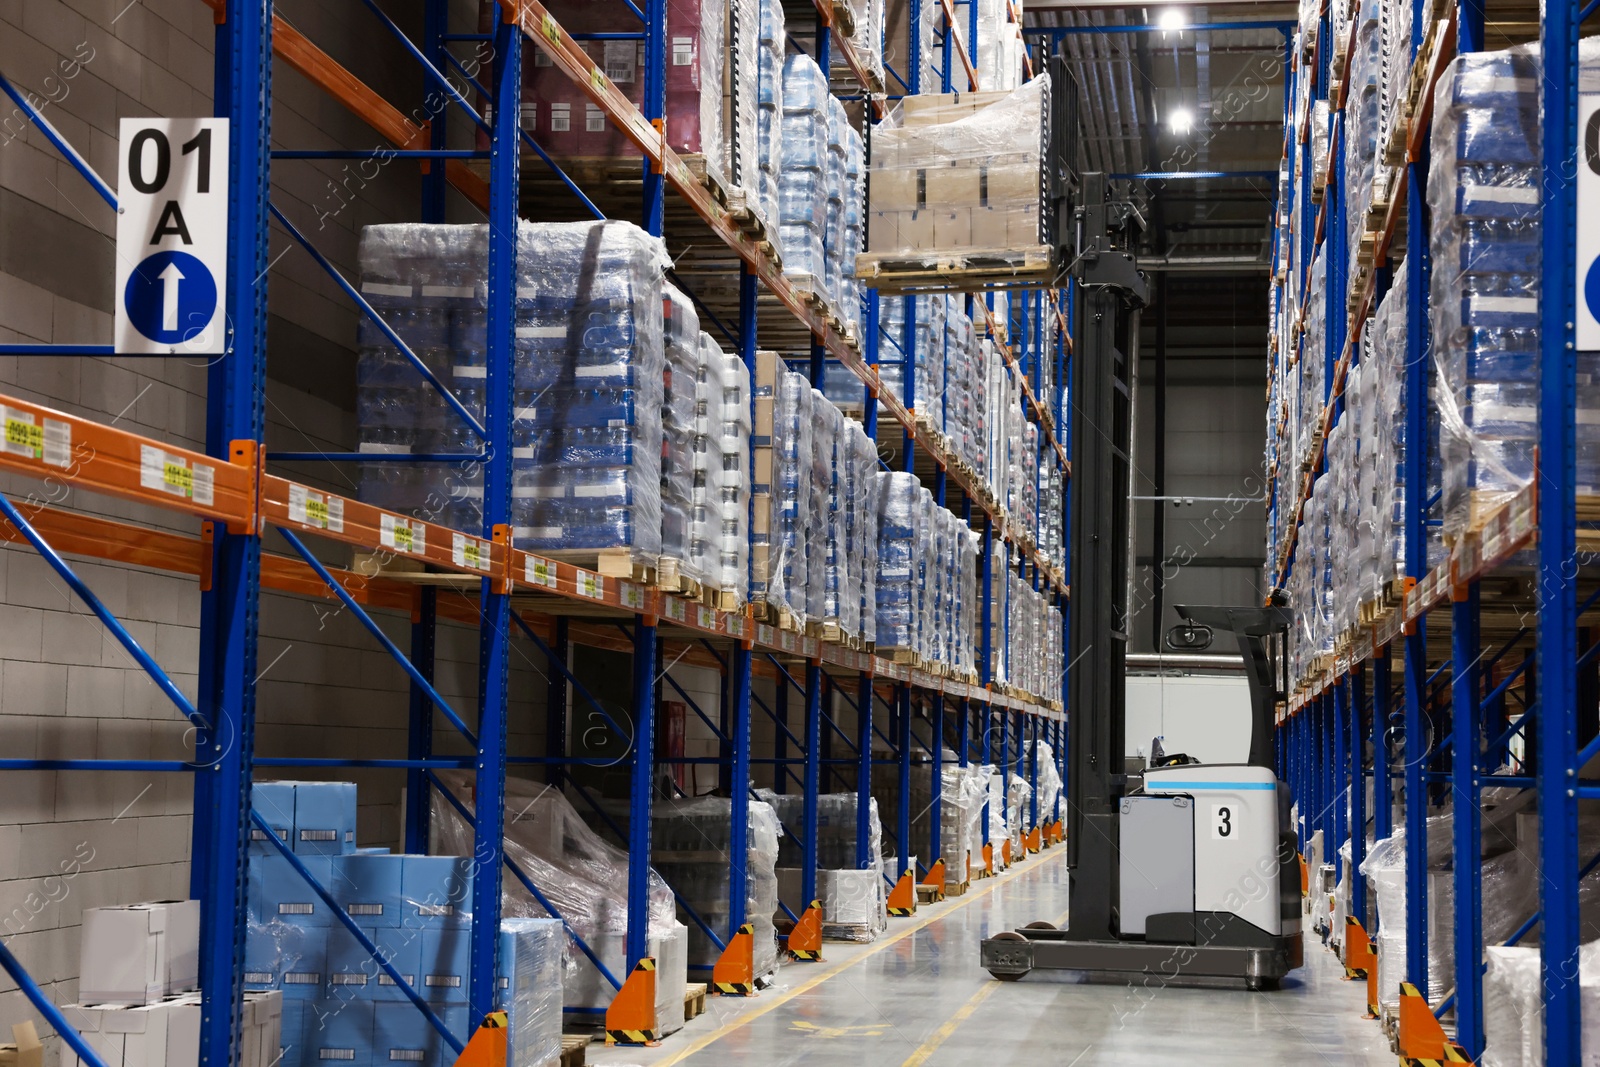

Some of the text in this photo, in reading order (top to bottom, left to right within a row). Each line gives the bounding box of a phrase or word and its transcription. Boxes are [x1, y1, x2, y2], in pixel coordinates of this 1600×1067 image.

[127, 127, 213, 195] 01
[149, 199, 194, 246] A
[1217, 806, 1232, 837] 3
